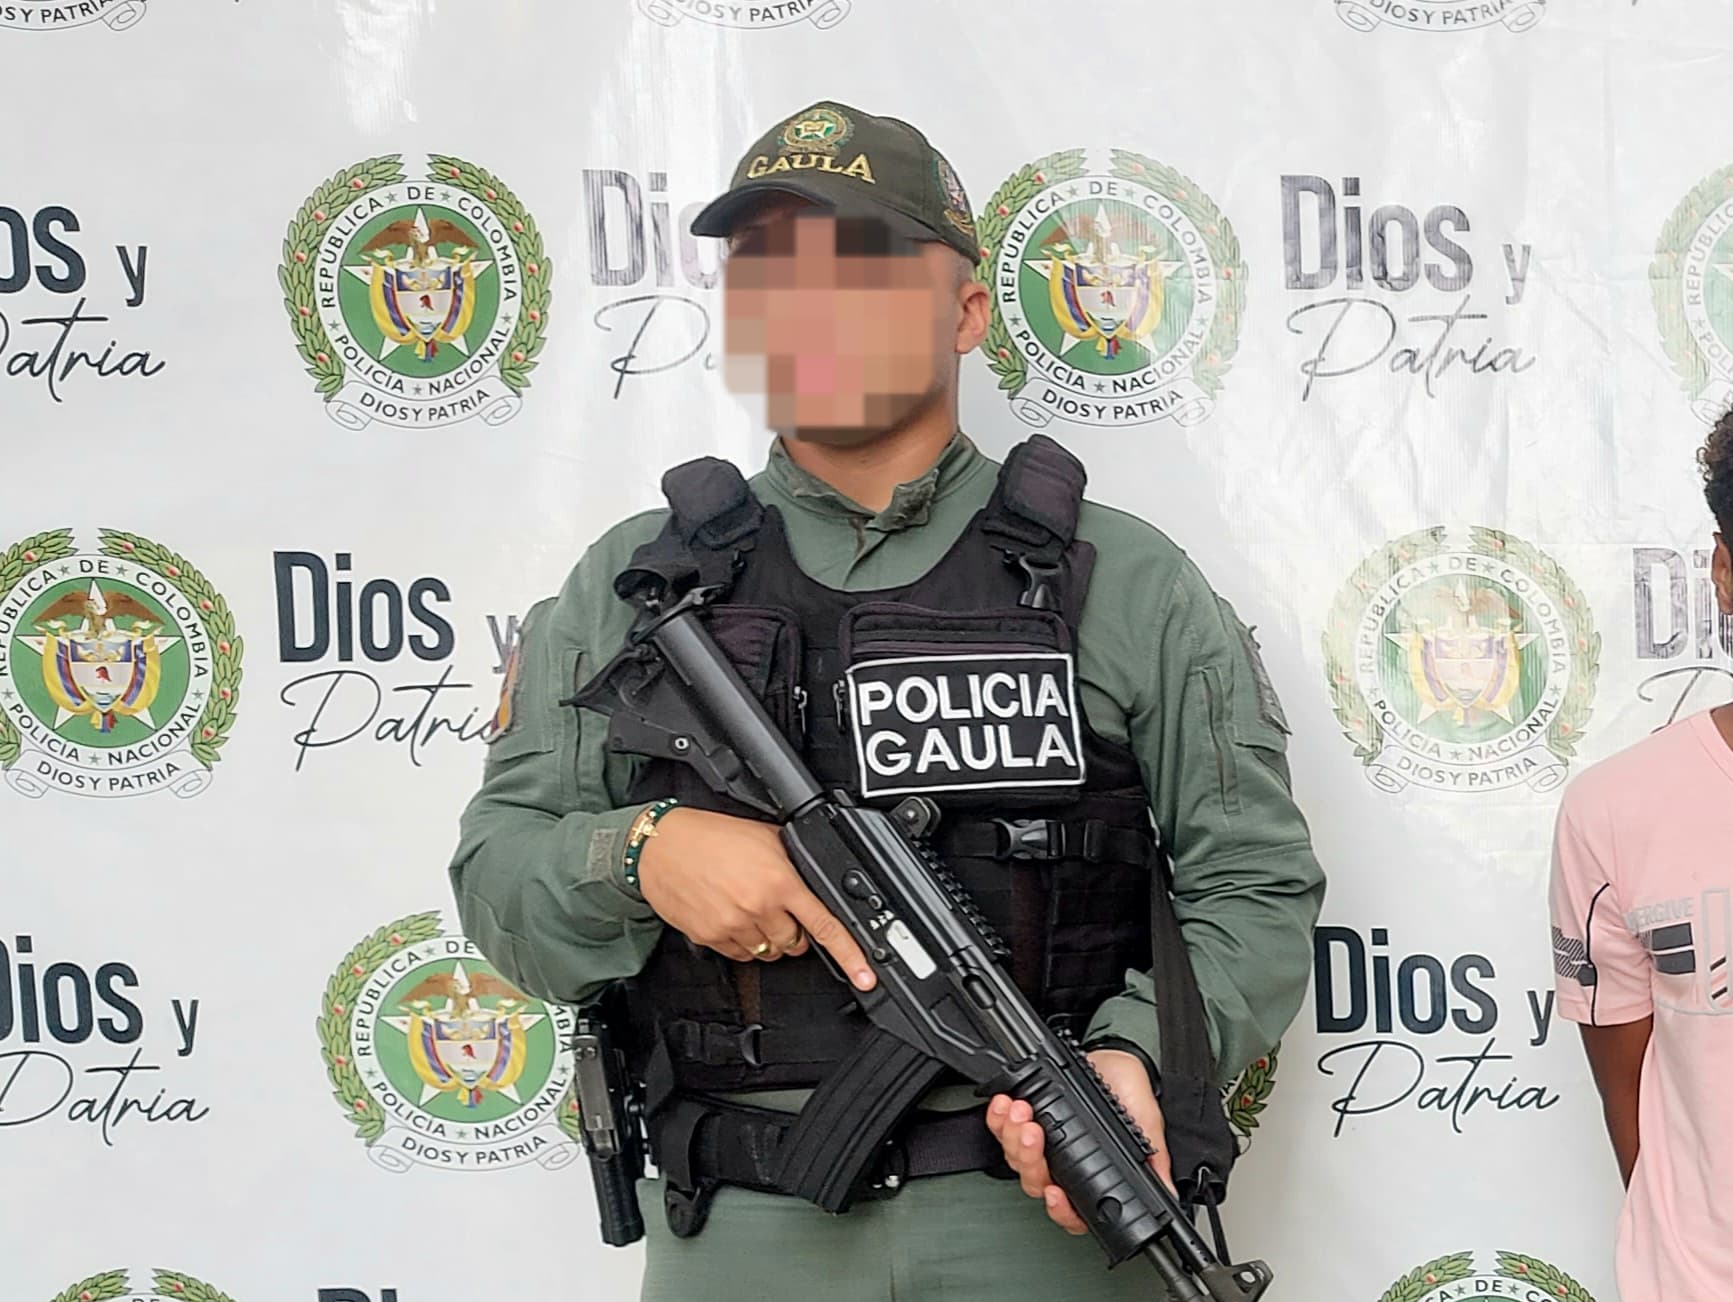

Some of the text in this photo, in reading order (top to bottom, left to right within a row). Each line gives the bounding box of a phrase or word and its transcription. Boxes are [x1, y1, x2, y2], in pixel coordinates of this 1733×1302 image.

[747, 154, 876, 185] GAULA
[406, 186, 436, 200] DE
[458, 197, 518, 301] COLOMBIA
[583, 169, 722, 290] Dio
[1089, 181, 1119, 195] DE
[1143, 193, 1212, 303] COLOMBIA
[1279, 174, 1533, 304] Dios y
[115, 246, 147, 307] y
[0, 297, 166, 403] atria
[428, 328, 511, 395] NACIONAL
[1113, 330, 1204, 394] NACIONAL
[1287, 294, 1537, 402] Patria
[428, 389, 491, 420] PATRIA
[1113, 391, 1182, 420] PATRIA
[1448, 558, 1478, 571] DE
[80, 560, 112, 573] DE
[136, 572, 208, 677] COLOMBIA
[273, 551, 454, 662] Dios
[860, 672, 1069, 727] POLICIA
[1468, 699, 1559, 760] NACIONAL
[109, 704, 201, 765] NACIONAL
[865, 721, 1077, 776] GAULA
[109, 762, 180, 791] PATRIA
[1468, 757, 1537, 786] PATRIA
[445, 941, 477, 954] DE
[1315, 926, 1556, 1046] Dios y
[171, 999, 199, 1057] y
[475, 1079, 567, 1140] NACIONAL
[1317, 1036, 1561, 1138] Patria
[475, 1136, 547, 1165] PATRIA
[1475, 1280, 1504, 1292] DE
